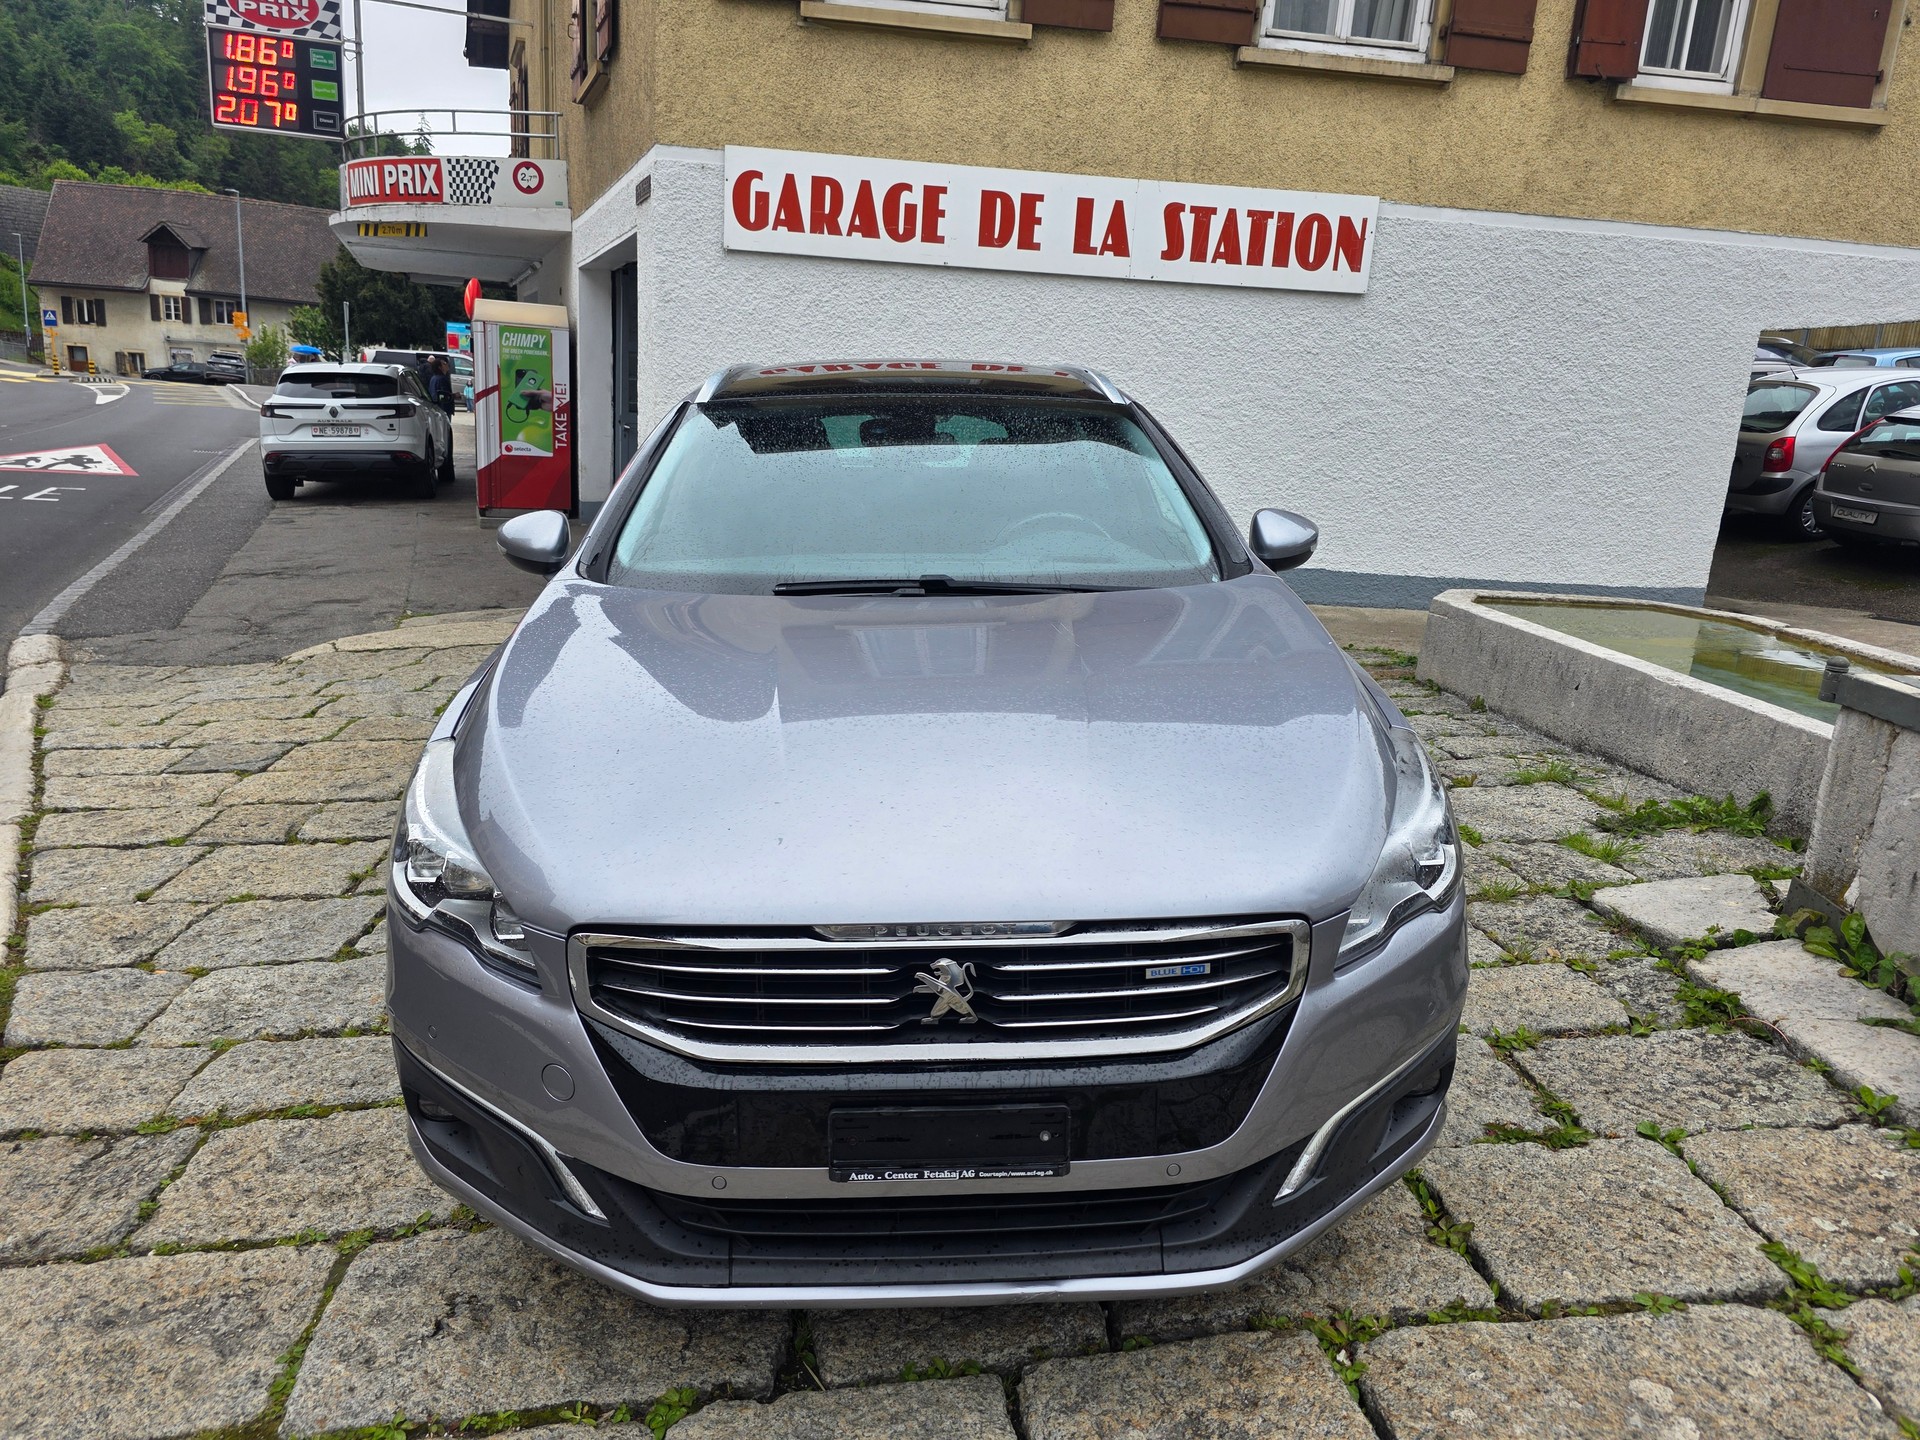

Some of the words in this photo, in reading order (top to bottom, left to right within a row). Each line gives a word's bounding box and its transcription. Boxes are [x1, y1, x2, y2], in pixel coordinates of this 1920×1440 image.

[238, 0, 311, 22] PRIX
[349, 165, 380, 198] MINI
[383, 163, 441, 196] PRIX
[732, 169, 948, 244] GARAGE
[978, 189, 1045, 252] DE
[1072, 196, 1131, 258] LA
[1160, 201, 1369, 273] STATION
[502, 331, 546, 349] CHIMPY
[554, 383, 567, 409] ME!
[554, 412, 567, 449] TAKE
[1837, 509, 1871, 520] QUALITY
[874, 923, 1017, 937] PEUGEOT
[1150, 967, 1178, 977] BLUE
[849, 1172, 875, 1181] Auto
[884, 1171, 919, 1180] Center
[923, 1169, 960, 1180] Fetahaj
[960, 1169, 976, 1178] AG
